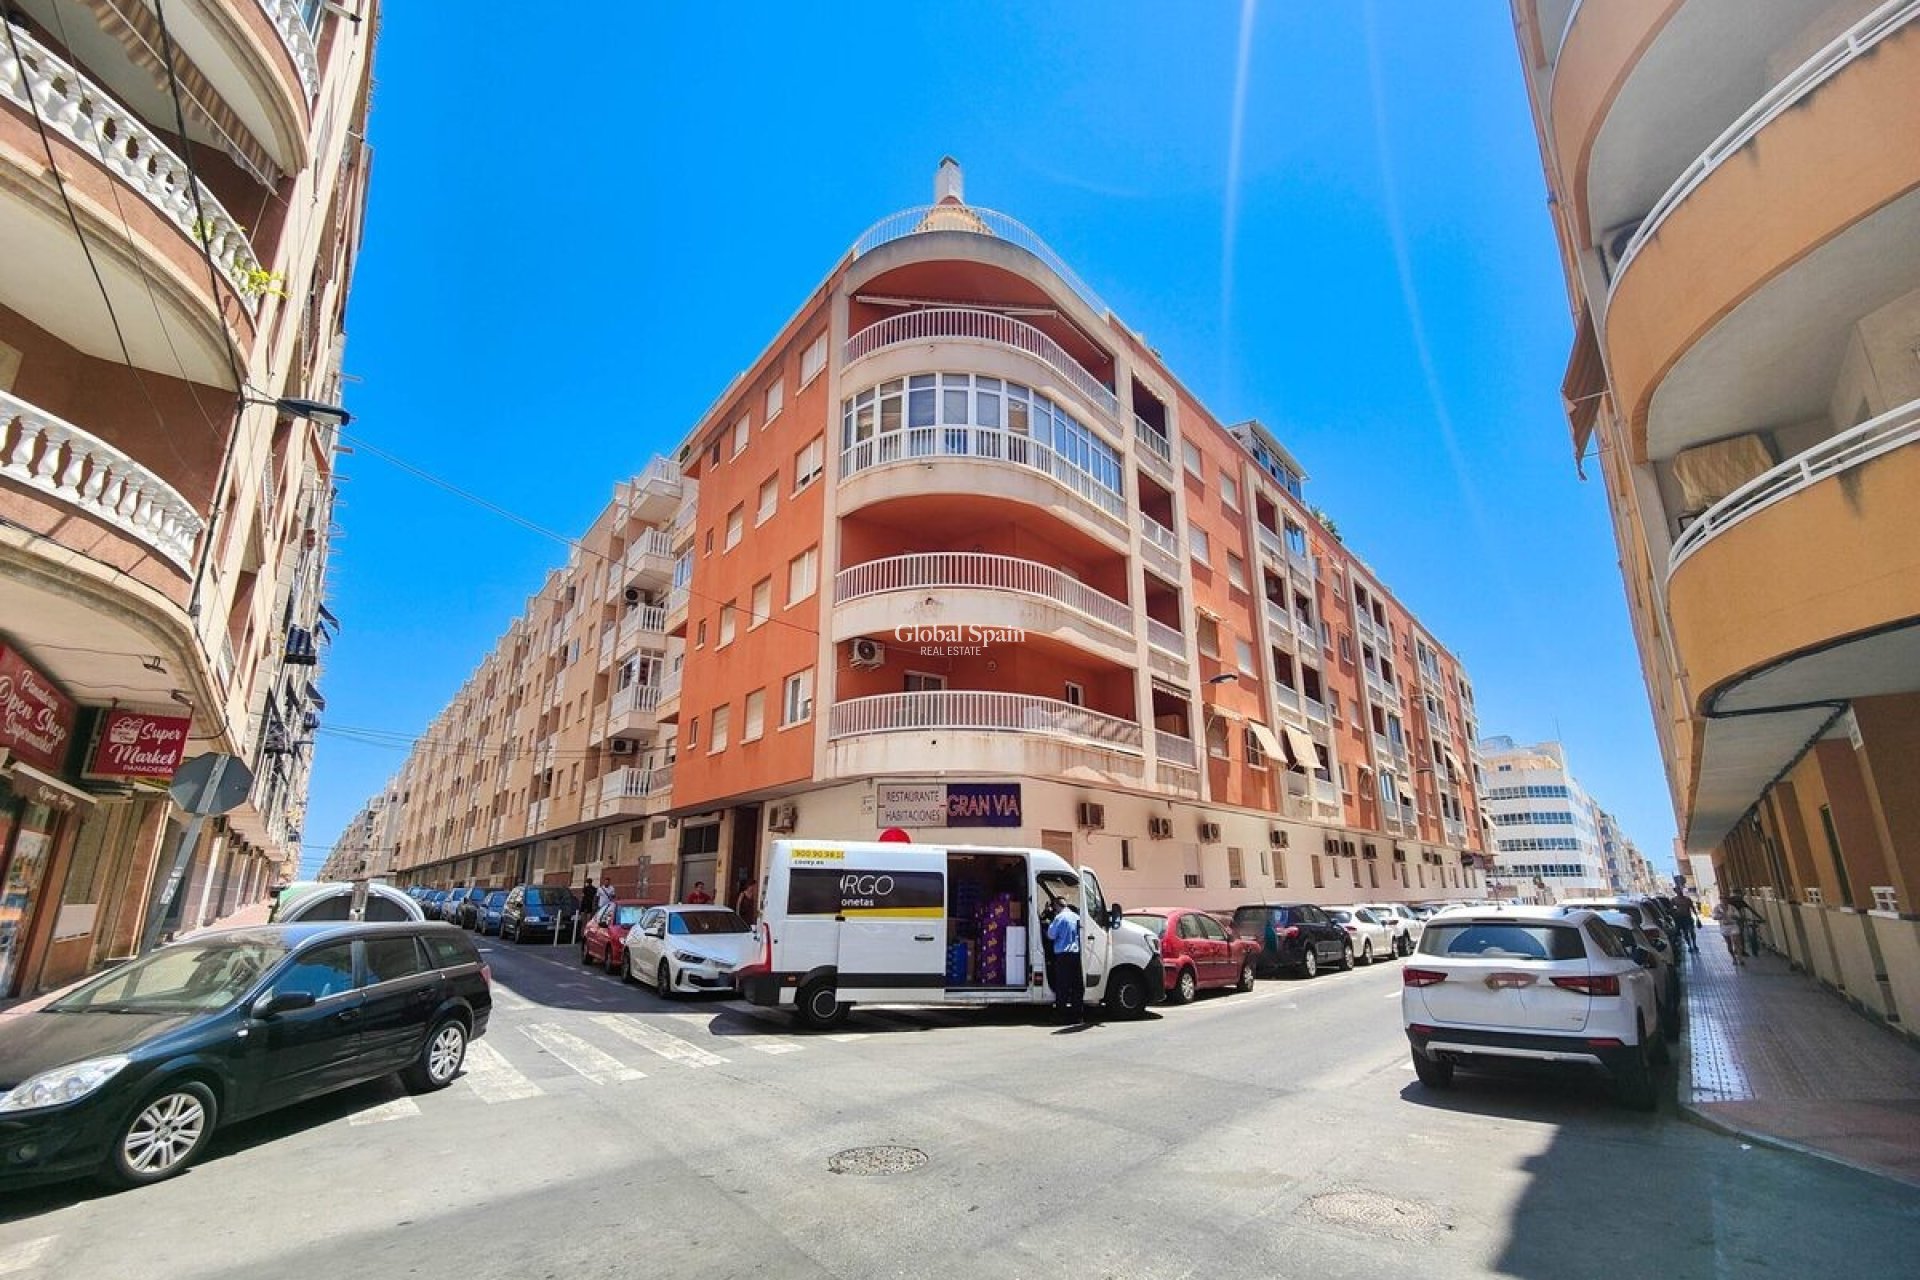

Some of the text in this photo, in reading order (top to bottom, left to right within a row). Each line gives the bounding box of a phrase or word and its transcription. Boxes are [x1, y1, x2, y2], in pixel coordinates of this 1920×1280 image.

[140, 722, 182, 744] Super
[108, 743, 177, 765] Market
[885, 791, 940, 802] RESTAURANTE
[947, 794, 1020, 818] GRAN VIA
[885, 809, 941, 822] HABITACIONES
